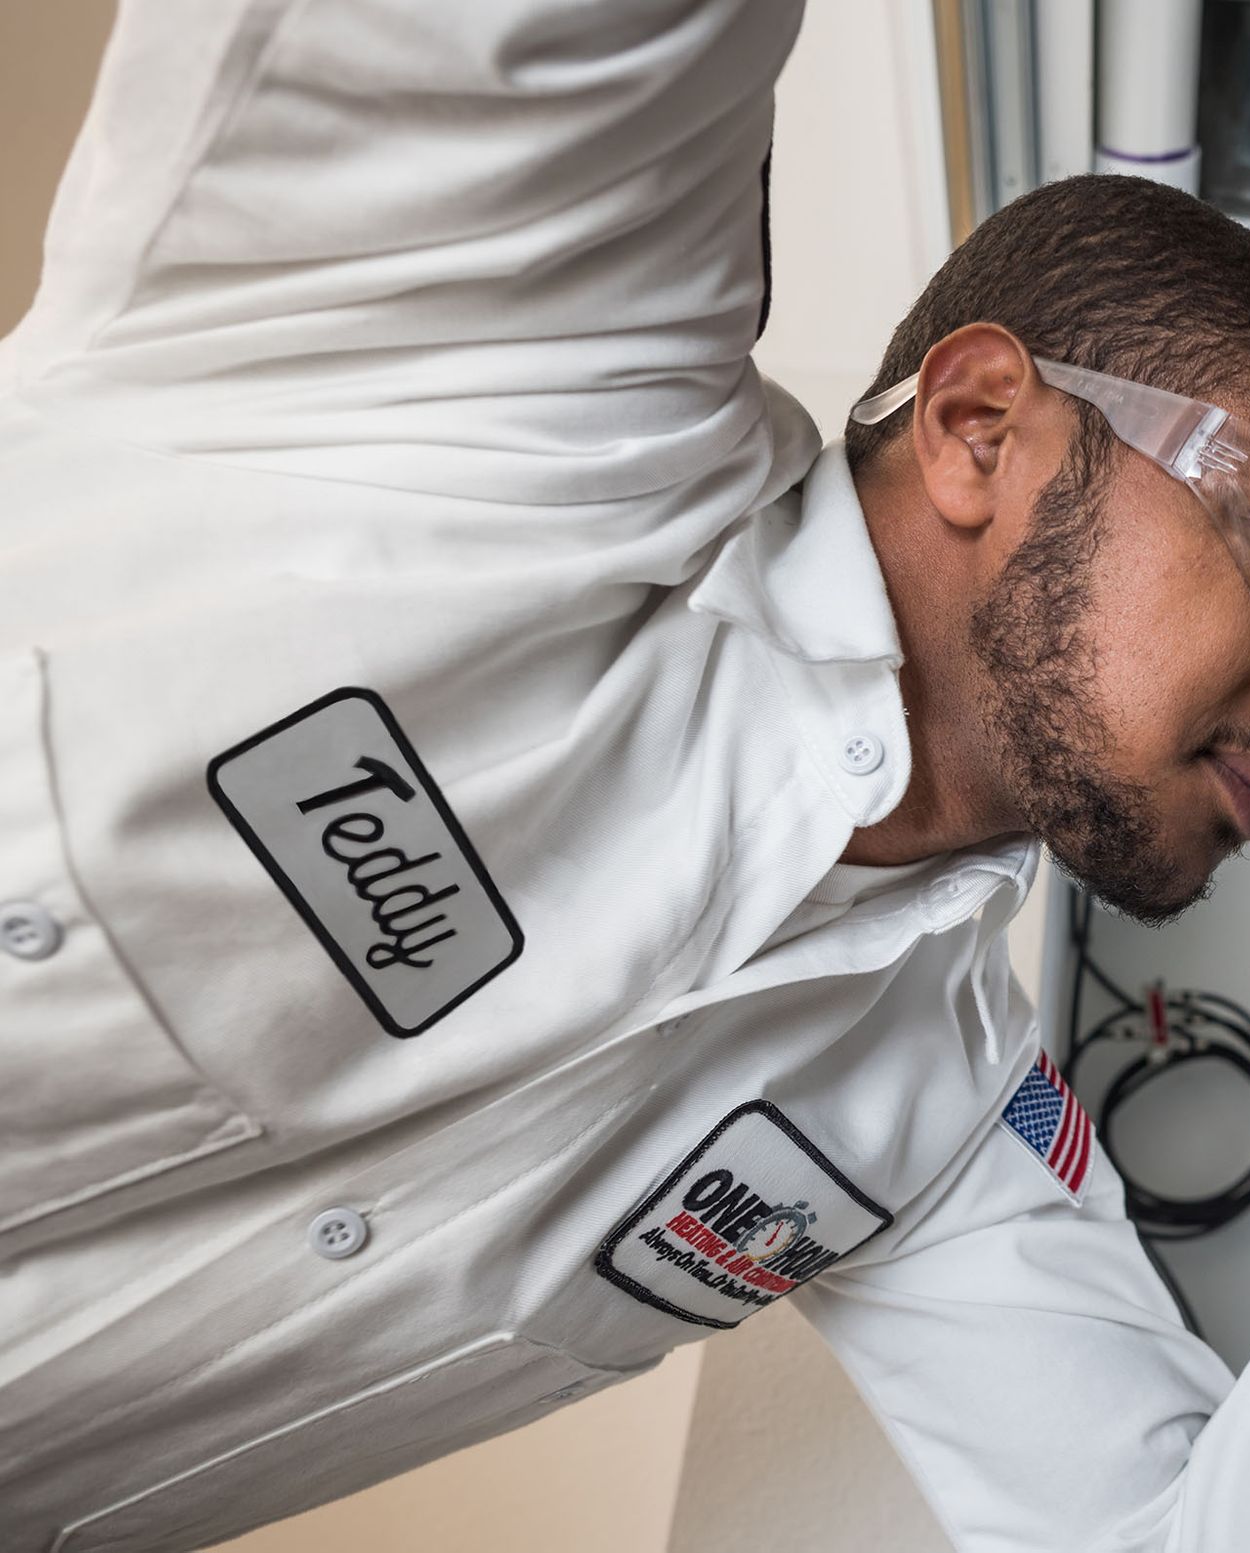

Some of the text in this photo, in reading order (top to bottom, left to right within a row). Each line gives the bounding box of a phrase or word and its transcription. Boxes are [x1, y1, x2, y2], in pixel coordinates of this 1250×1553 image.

[296, 755, 460, 969] Teddy
[683, 1169, 773, 1244] ONE
[639, 1227, 682, 1261] Always
[674, 1251, 696, 1273] On
[666, 1211, 727, 1258] HEATING
[715, 1249, 736, 1266] &
[724, 1255, 753, 1276] AIR
